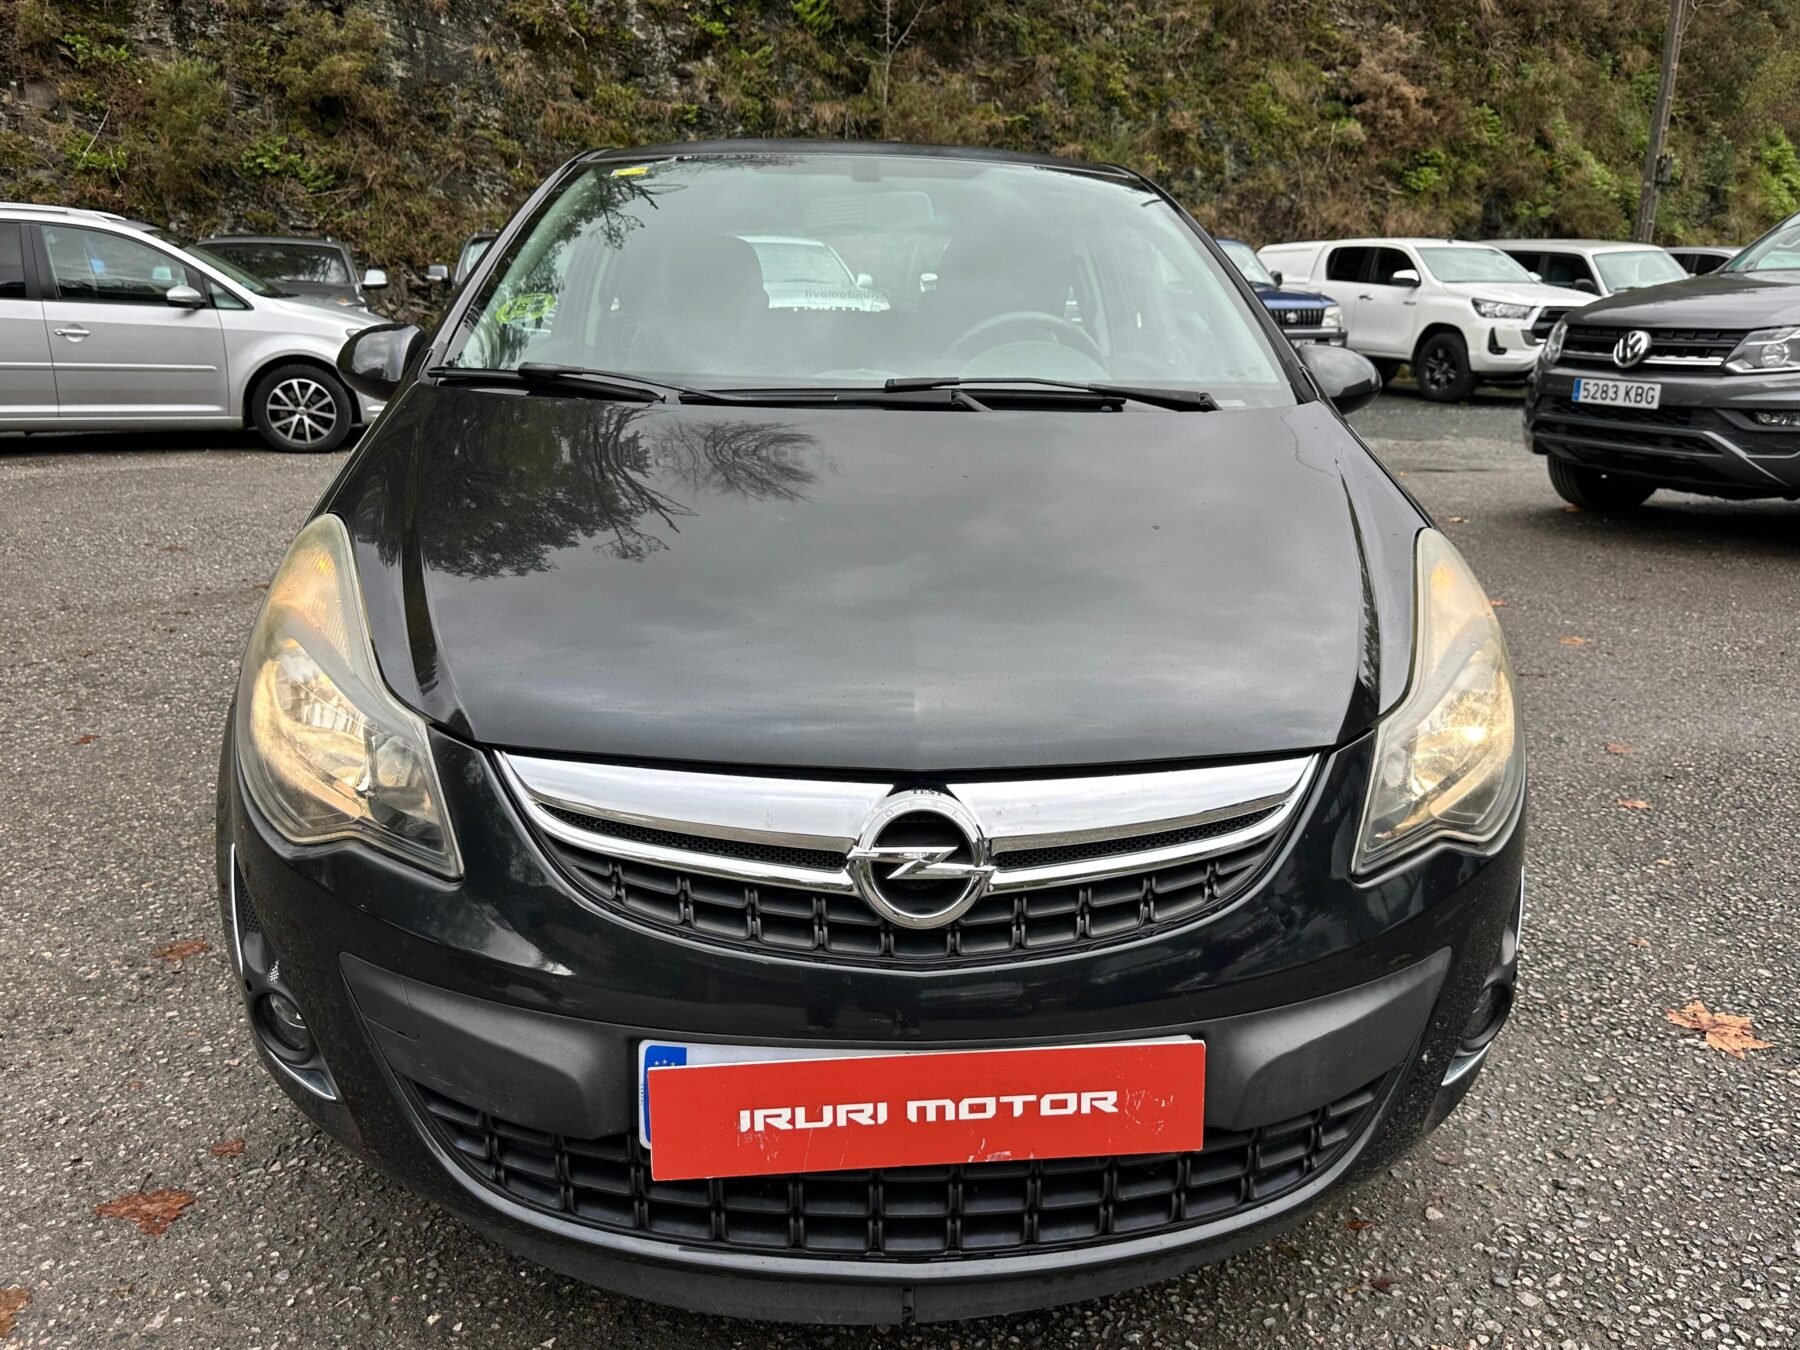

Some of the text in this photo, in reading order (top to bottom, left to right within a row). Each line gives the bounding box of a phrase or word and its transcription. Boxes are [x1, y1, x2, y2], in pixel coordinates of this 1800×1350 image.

[1582, 381, 1656, 405] 5283 KBG
[739, 1090, 1119, 1133] IRURI MOTOR
